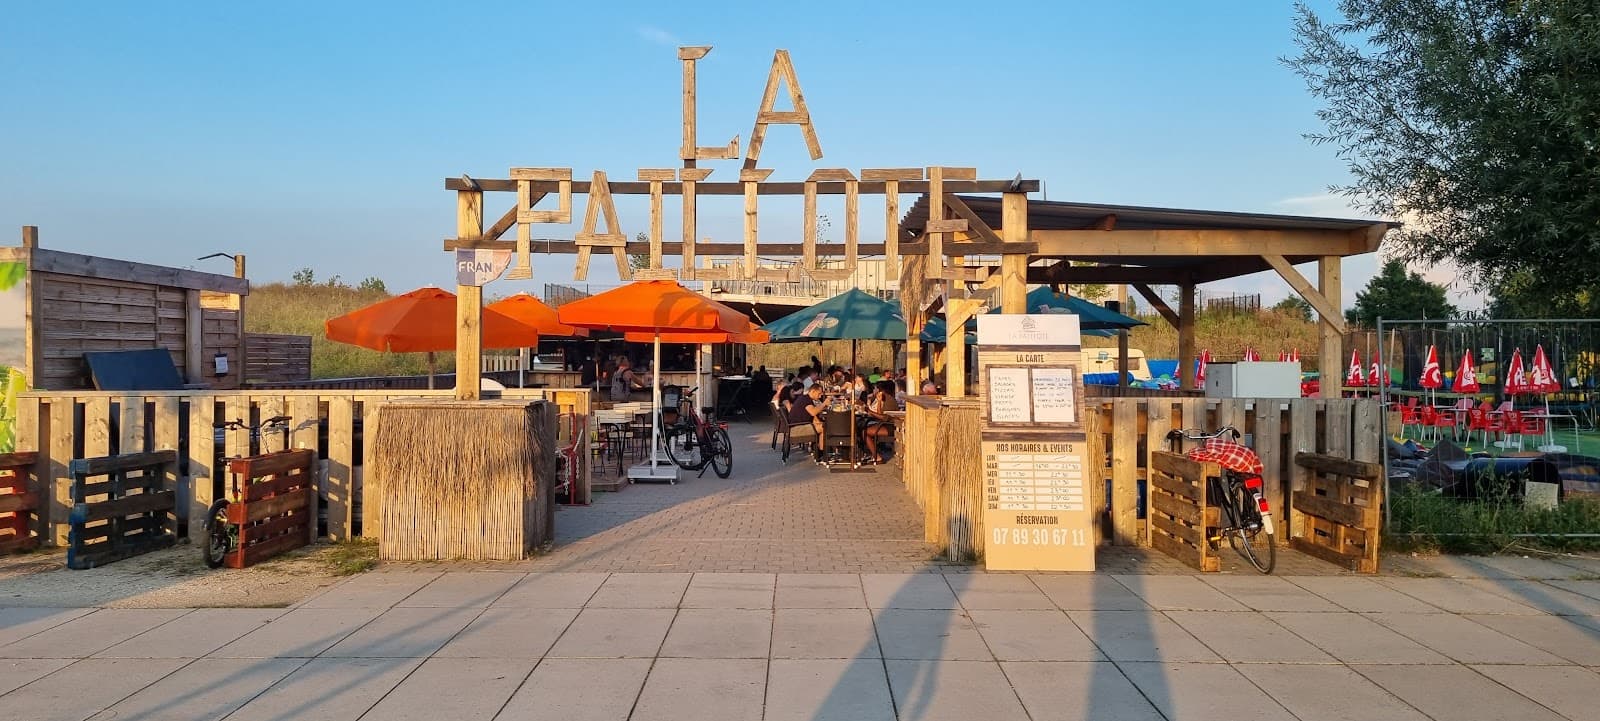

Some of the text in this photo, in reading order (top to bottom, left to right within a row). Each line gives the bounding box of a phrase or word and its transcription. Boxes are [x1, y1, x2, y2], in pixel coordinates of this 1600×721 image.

[677, 46, 823, 161] LA
[505, 166, 987, 282] PAILLOTE
[1016, 354, 1045, 363] LA CARTE
[996, 443, 1073, 453] NOS HORAIRES & EVENTS
[987, 470, 998, 478] MER
[988, 494, 999, 502] SAM
[1016, 513, 1058, 525] RÉSERVATION
[993, 527, 1086, 546] 07 89 30 67 11
